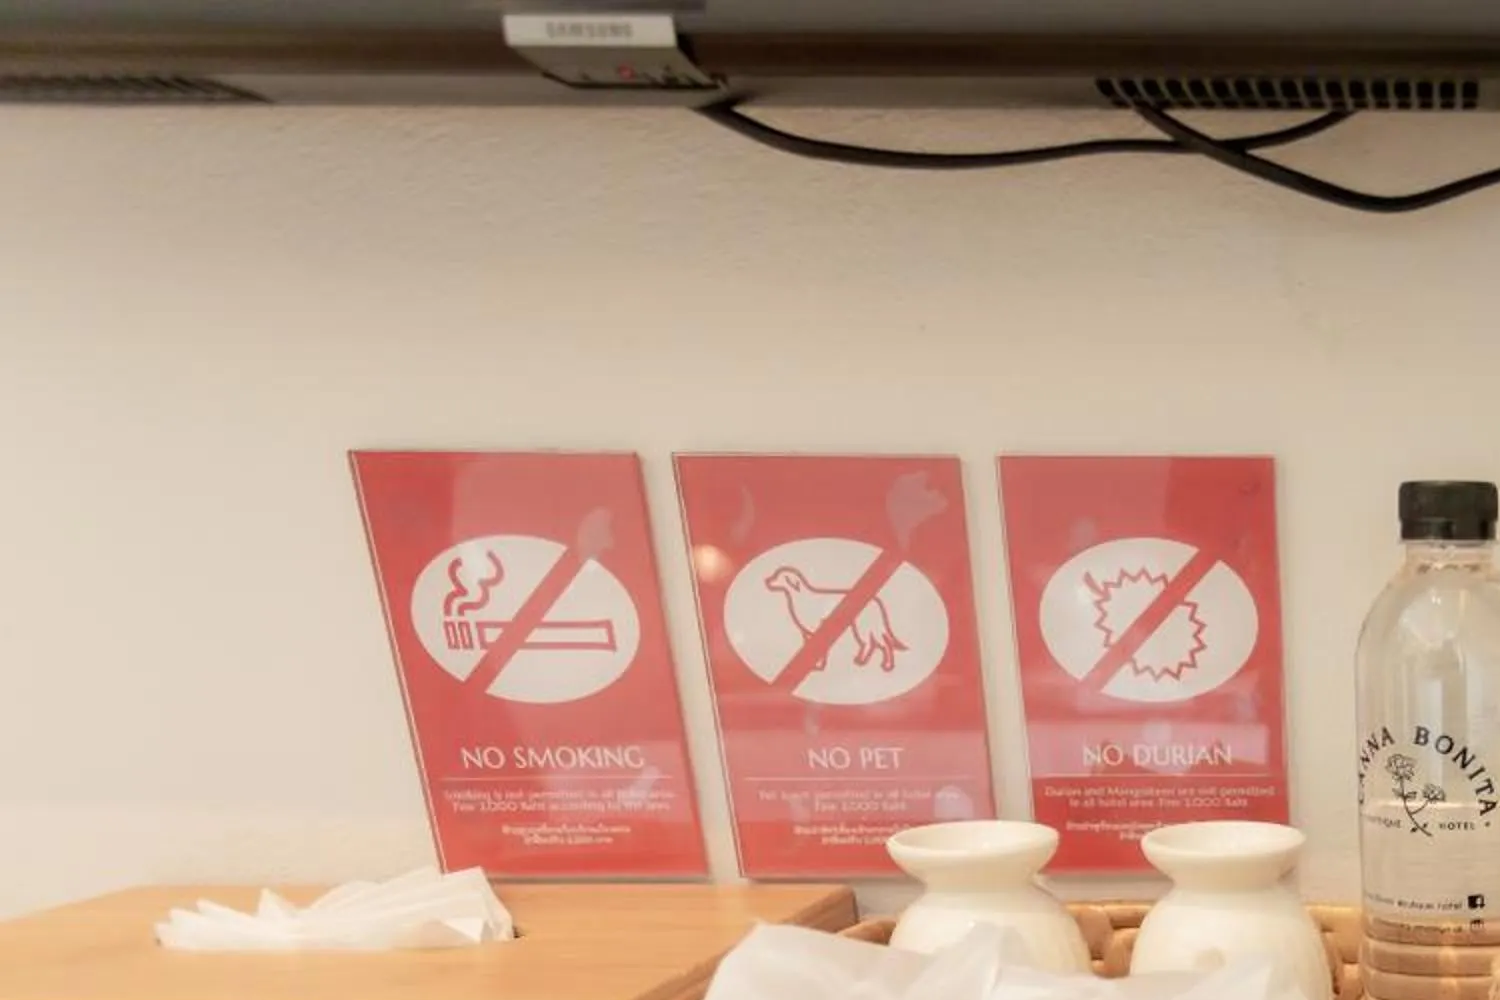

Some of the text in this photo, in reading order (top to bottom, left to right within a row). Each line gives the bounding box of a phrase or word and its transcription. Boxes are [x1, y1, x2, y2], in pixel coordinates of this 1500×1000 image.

[546, 22, 633, 38] SAMSUNG
[461, 745, 645, 769] NO SMOKING
[808, 746, 904, 769] NO PET
[1083, 744, 1233, 766] NO DURIAN
[1412, 725, 1499, 816] BONITA
